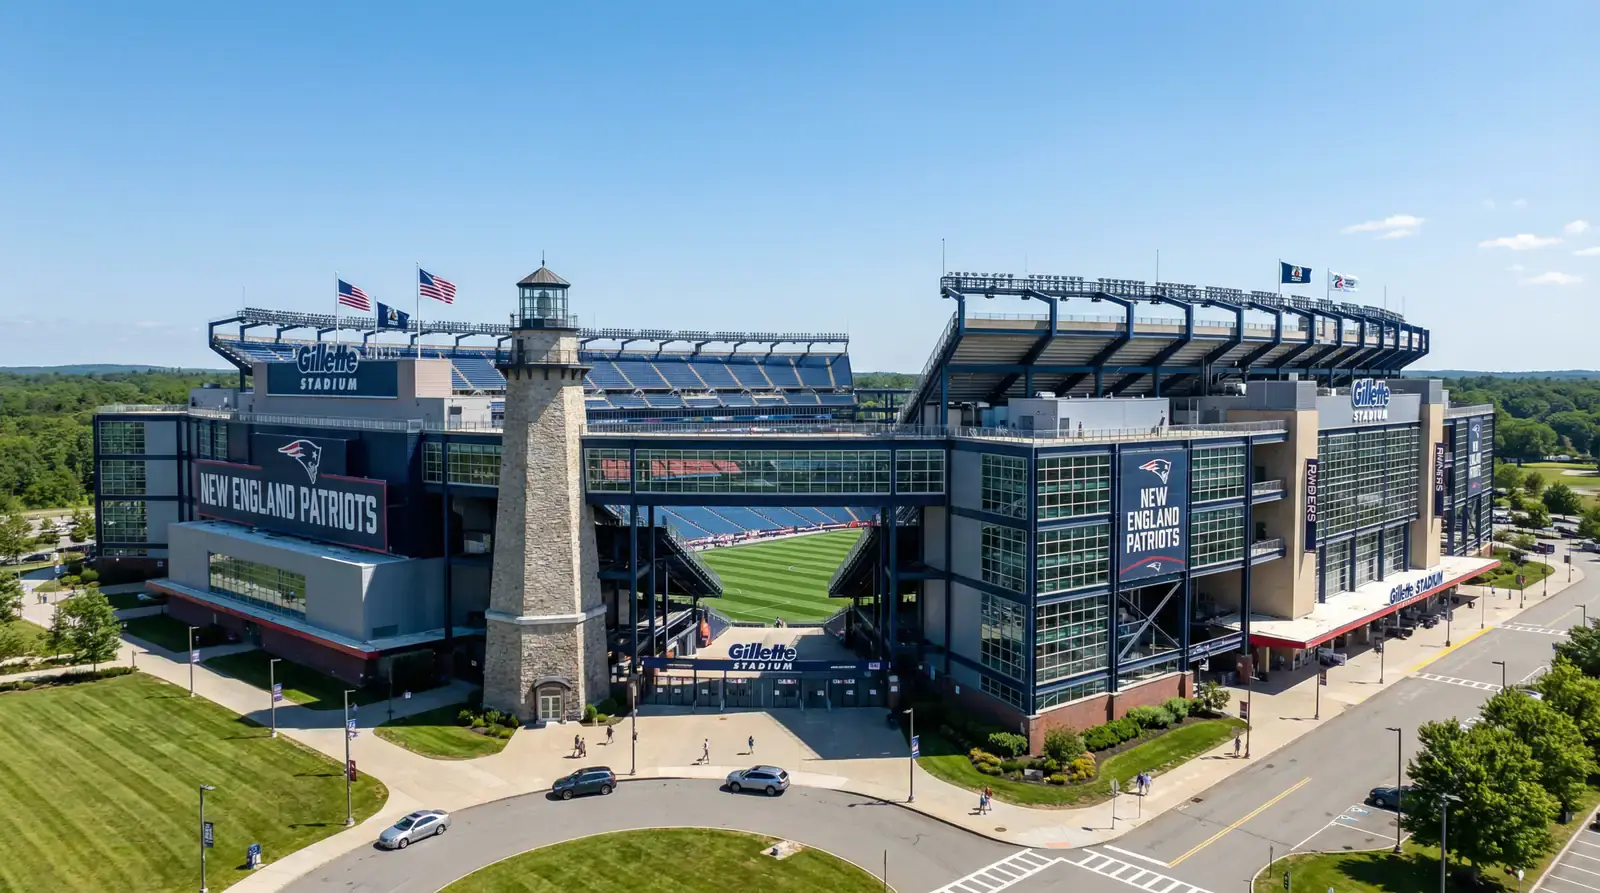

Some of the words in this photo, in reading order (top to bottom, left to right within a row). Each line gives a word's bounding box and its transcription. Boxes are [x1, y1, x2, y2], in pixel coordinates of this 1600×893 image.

[297, 342, 359, 374] Gillette
[300, 377, 357, 391] STADIUM
[1352, 378, 1391, 408] Gillette
[1353, 410, 1388, 422] STADIUM
[200, 472, 229, 508] NEW
[232, 476, 296, 520] ENGLAND
[300, 486, 378, 535] PATRIOTS
[1140, 486, 1168, 509] NEW
[1127, 506, 1180, 532] ENGLAND
[1126, 527, 1180, 554] PATRIOTS
[1390, 582, 1414, 605] Gillette
[1415, 570, 1443, 594] STADIUM
[728, 642, 797, 662] Gillette
[733, 662, 793, 670] STADIUM
